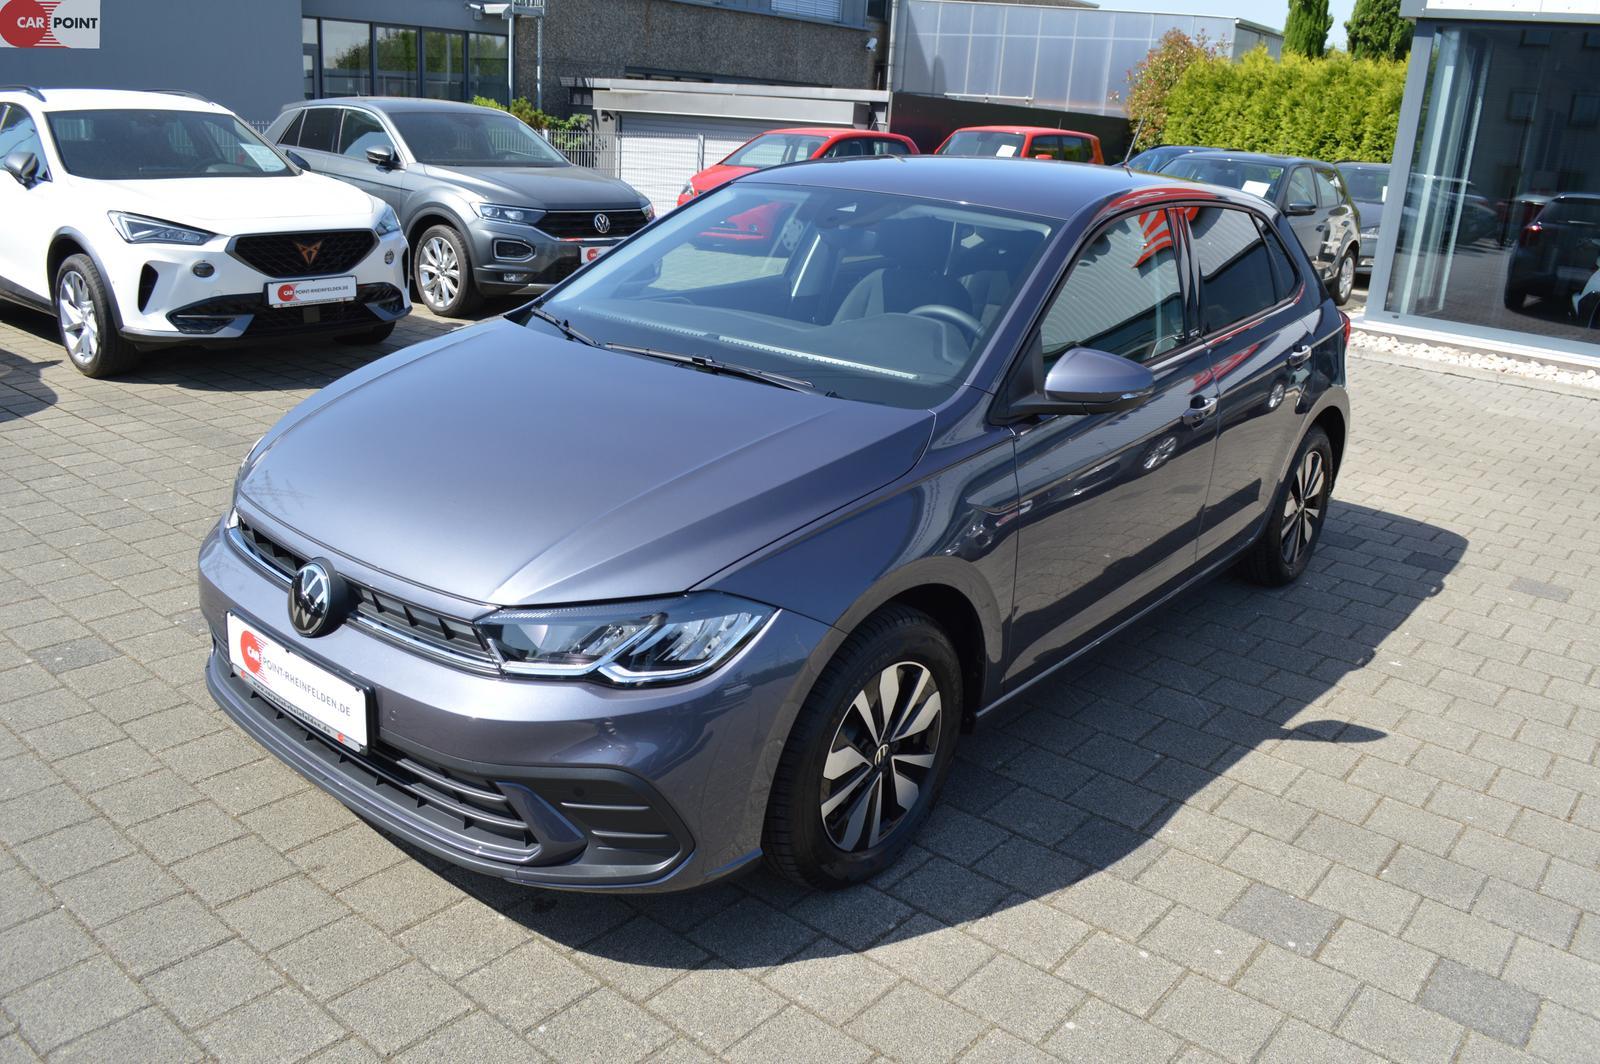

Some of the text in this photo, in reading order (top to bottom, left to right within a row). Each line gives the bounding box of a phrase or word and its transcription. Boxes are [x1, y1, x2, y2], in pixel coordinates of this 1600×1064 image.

[16, 16, 98, 29] CAR POINT
[263, 656, 351, 717] POINT-RHEINFELDEN.DE
